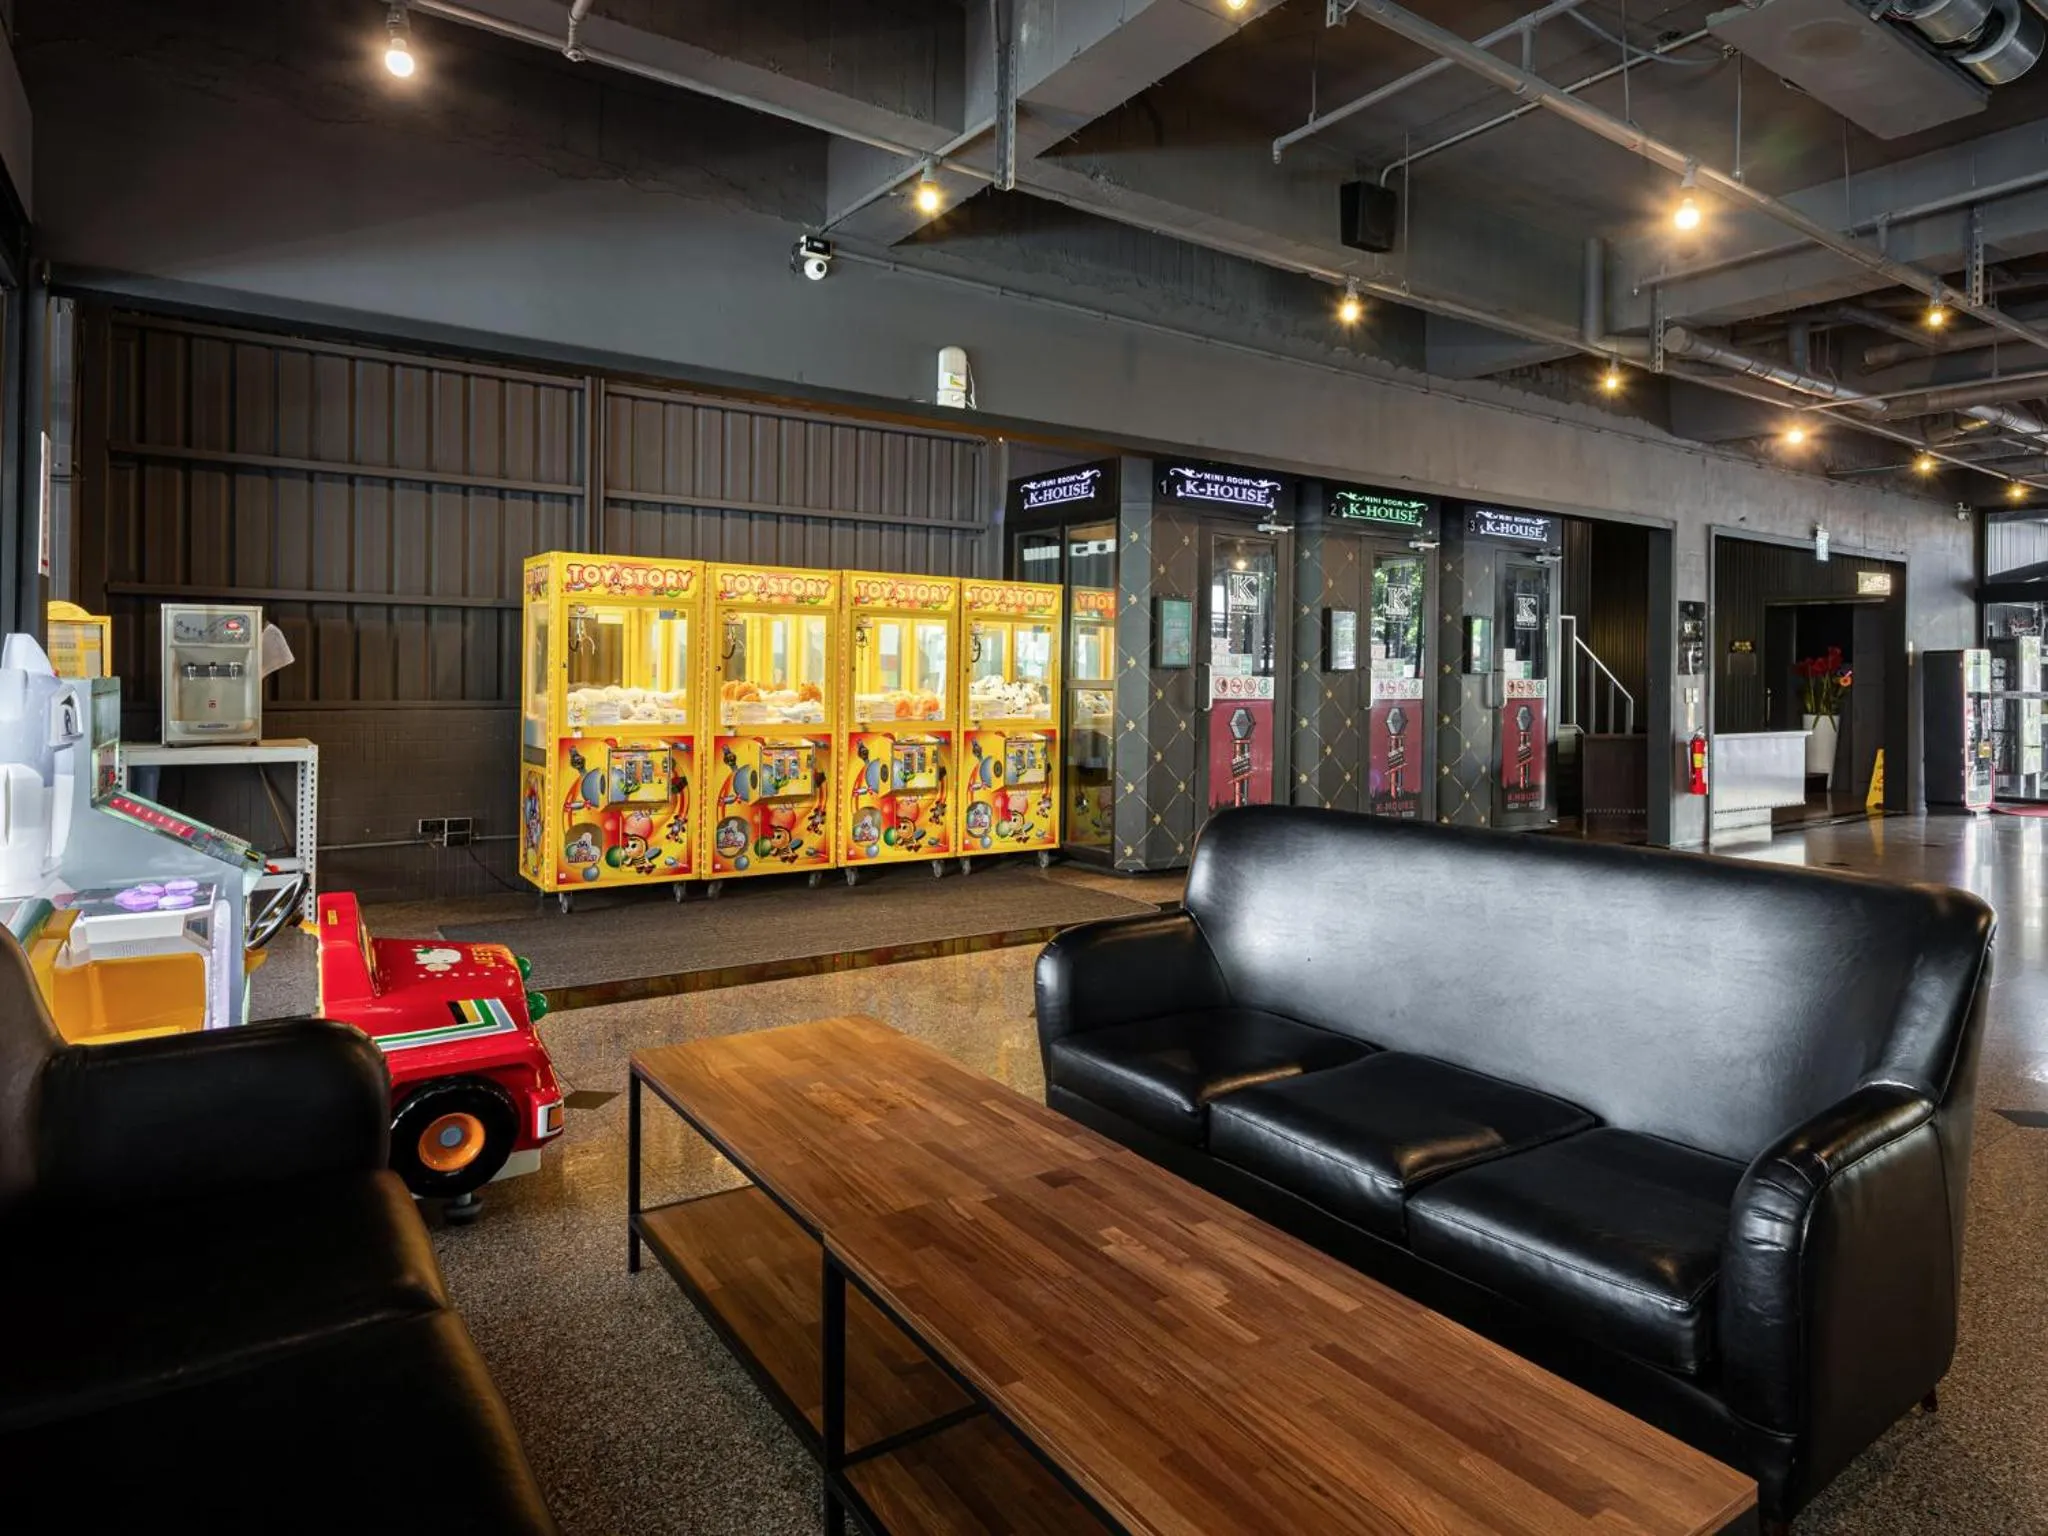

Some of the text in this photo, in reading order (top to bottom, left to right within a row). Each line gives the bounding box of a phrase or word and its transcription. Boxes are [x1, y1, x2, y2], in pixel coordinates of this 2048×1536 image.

[1030, 482, 1089, 504] K-HOUSE
[1160, 480, 1167, 494] 1
[1185, 480, 1268, 503] K-HOUSE
[1330, 503, 1337, 516] 2
[1349, 503, 1417, 522] K-HOUSE
[1470, 520, 1476, 532] 3
[1486, 520, 1542, 538] K-HOUSE
[567, 564, 619, 589] TOY
[619, 567, 695, 592] STORY
[720, 574, 832, 598] TOY STORY
[856, 580, 952, 603] TOY STORY
[970, 586, 1056, 606] TOY STORY
